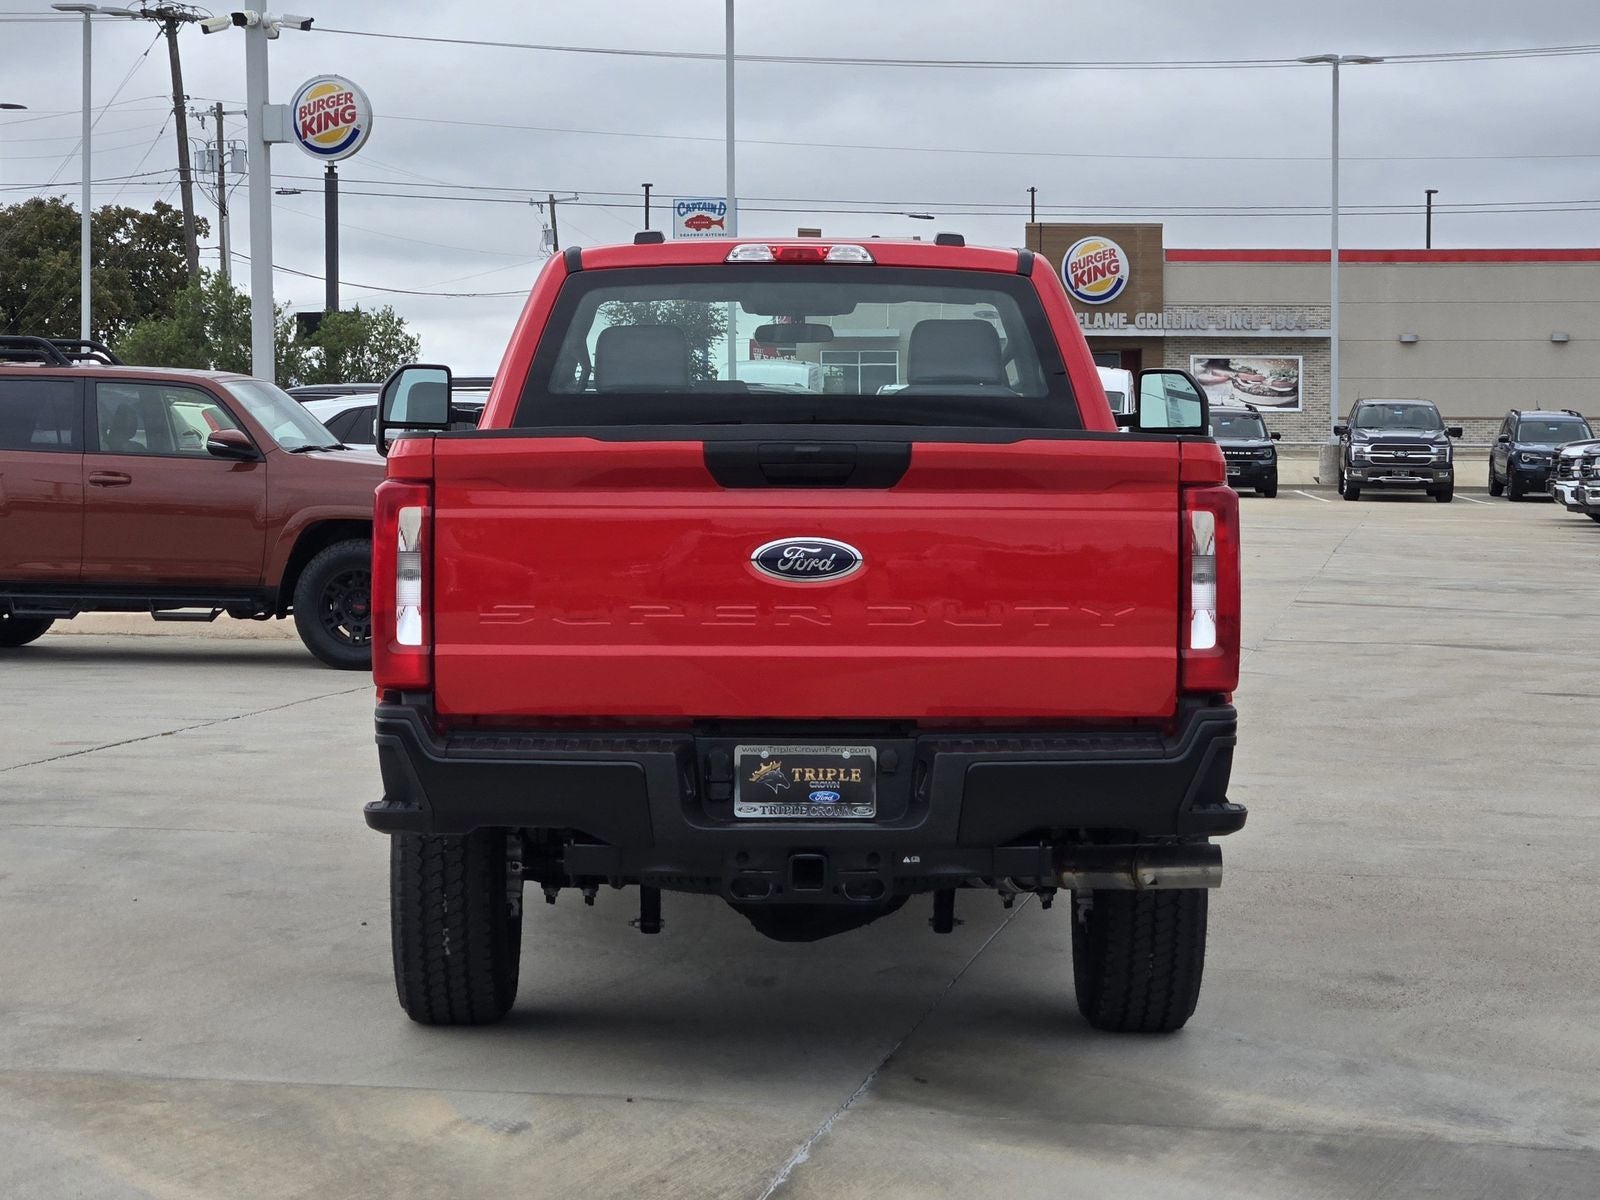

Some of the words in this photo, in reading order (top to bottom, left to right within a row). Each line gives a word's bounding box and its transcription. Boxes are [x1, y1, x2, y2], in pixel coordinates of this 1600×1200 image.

[299, 92, 354, 121] BURGER
[301, 104, 357, 140] KING
[677, 201, 717, 217] CAPTAIN
[1070, 248, 1117, 275] BURGER
[1073, 258, 1120, 290] KING
[1076, 312, 1127, 329] FLAME
[1135, 312, 1209, 330] GRILLING
[1215, 312, 1260, 330] SINCE
[777, 546, 836, 571] Ford
[479, 604, 832, 626] SUPER
[866, 606, 1135, 627] DUTY
[791, 768, 862, 782] TRIPLE
[814, 793, 834, 801] Ford
[760, 805, 807, 815] TRIPLE
[809, 807, 850, 816] CROWN
